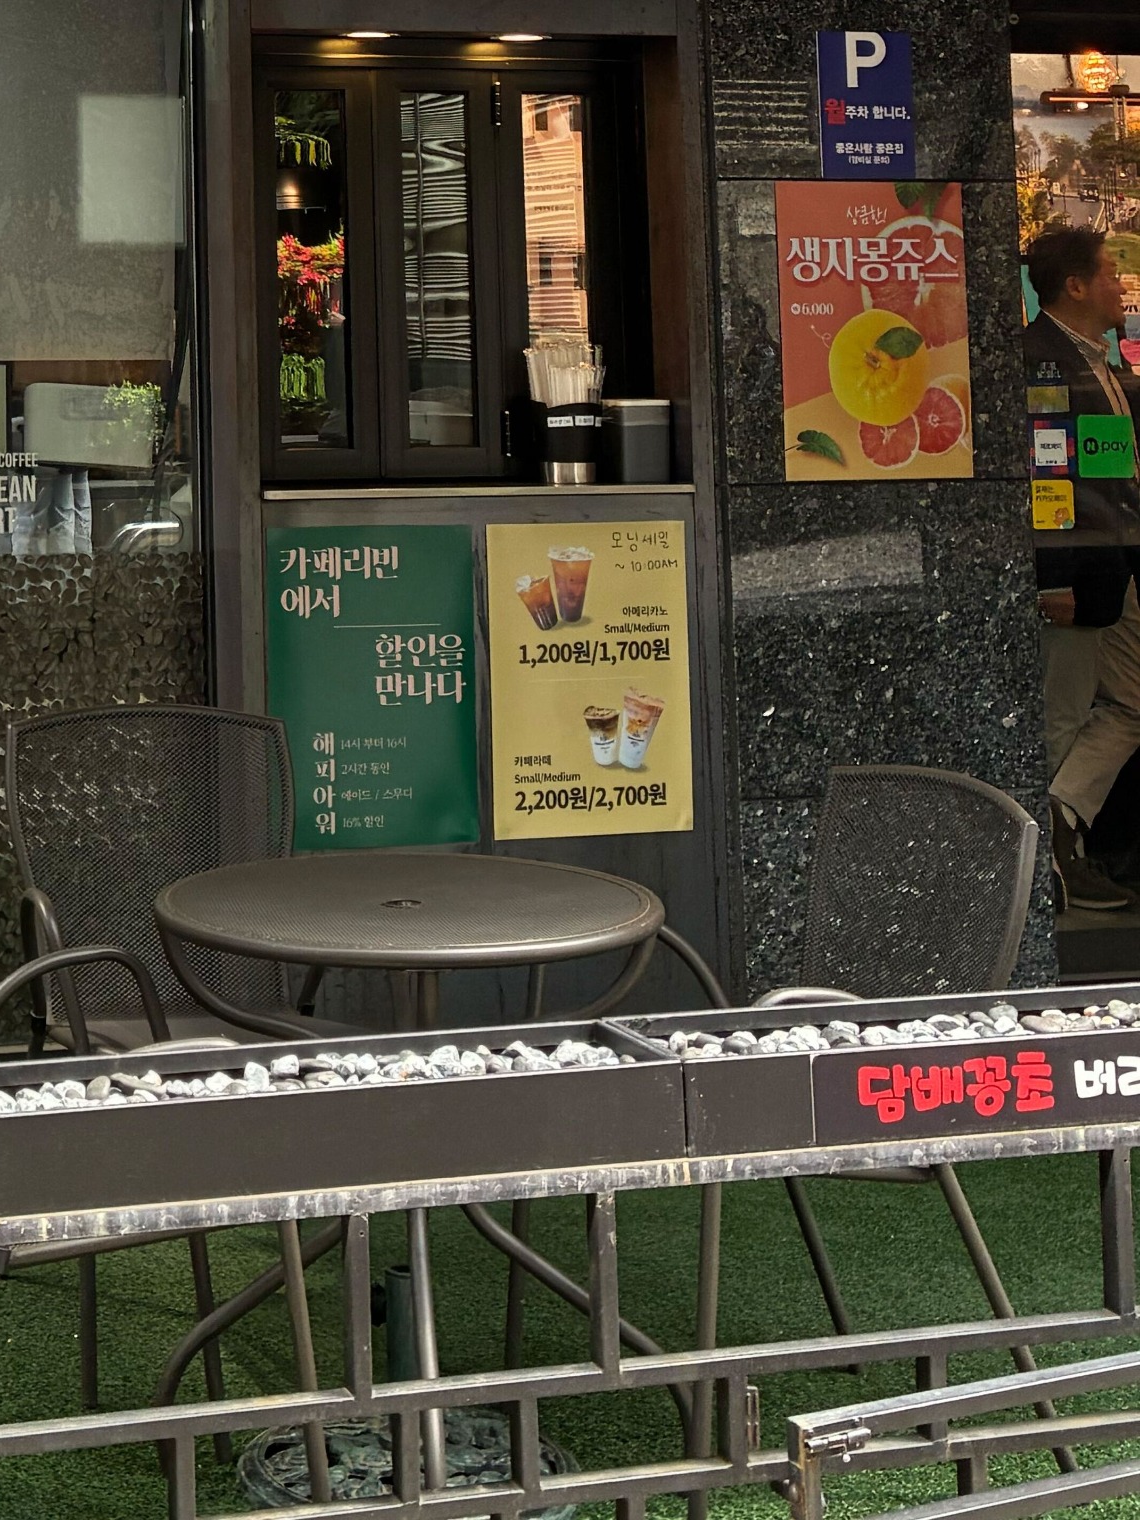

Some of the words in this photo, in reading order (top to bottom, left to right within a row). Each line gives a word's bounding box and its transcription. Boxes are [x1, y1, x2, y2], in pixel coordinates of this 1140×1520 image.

[845, 31, 887, 88] P
[872, 105, 911, 120] 합니다.
[786, 236, 959, 282] 생자몽쥬스
[280, 546, 398, 580] 카페리빈
[280, 585, 340, 619] 에서
[622, 606, 668, 616] 아메리카노
[604, 623, 670, 634] Small/Medium
[375, 633, 466, 668] 할인을
[519, 638, 671, 668] 1,200원/1,700원
[374, 671, 467, 706] 만나다
[514, 771, 581, 784] Small/Medium
[514, 782, 667, 815] 2,200원/2,700원
[858, 1051, 1055, 1123] 담배꽁초
